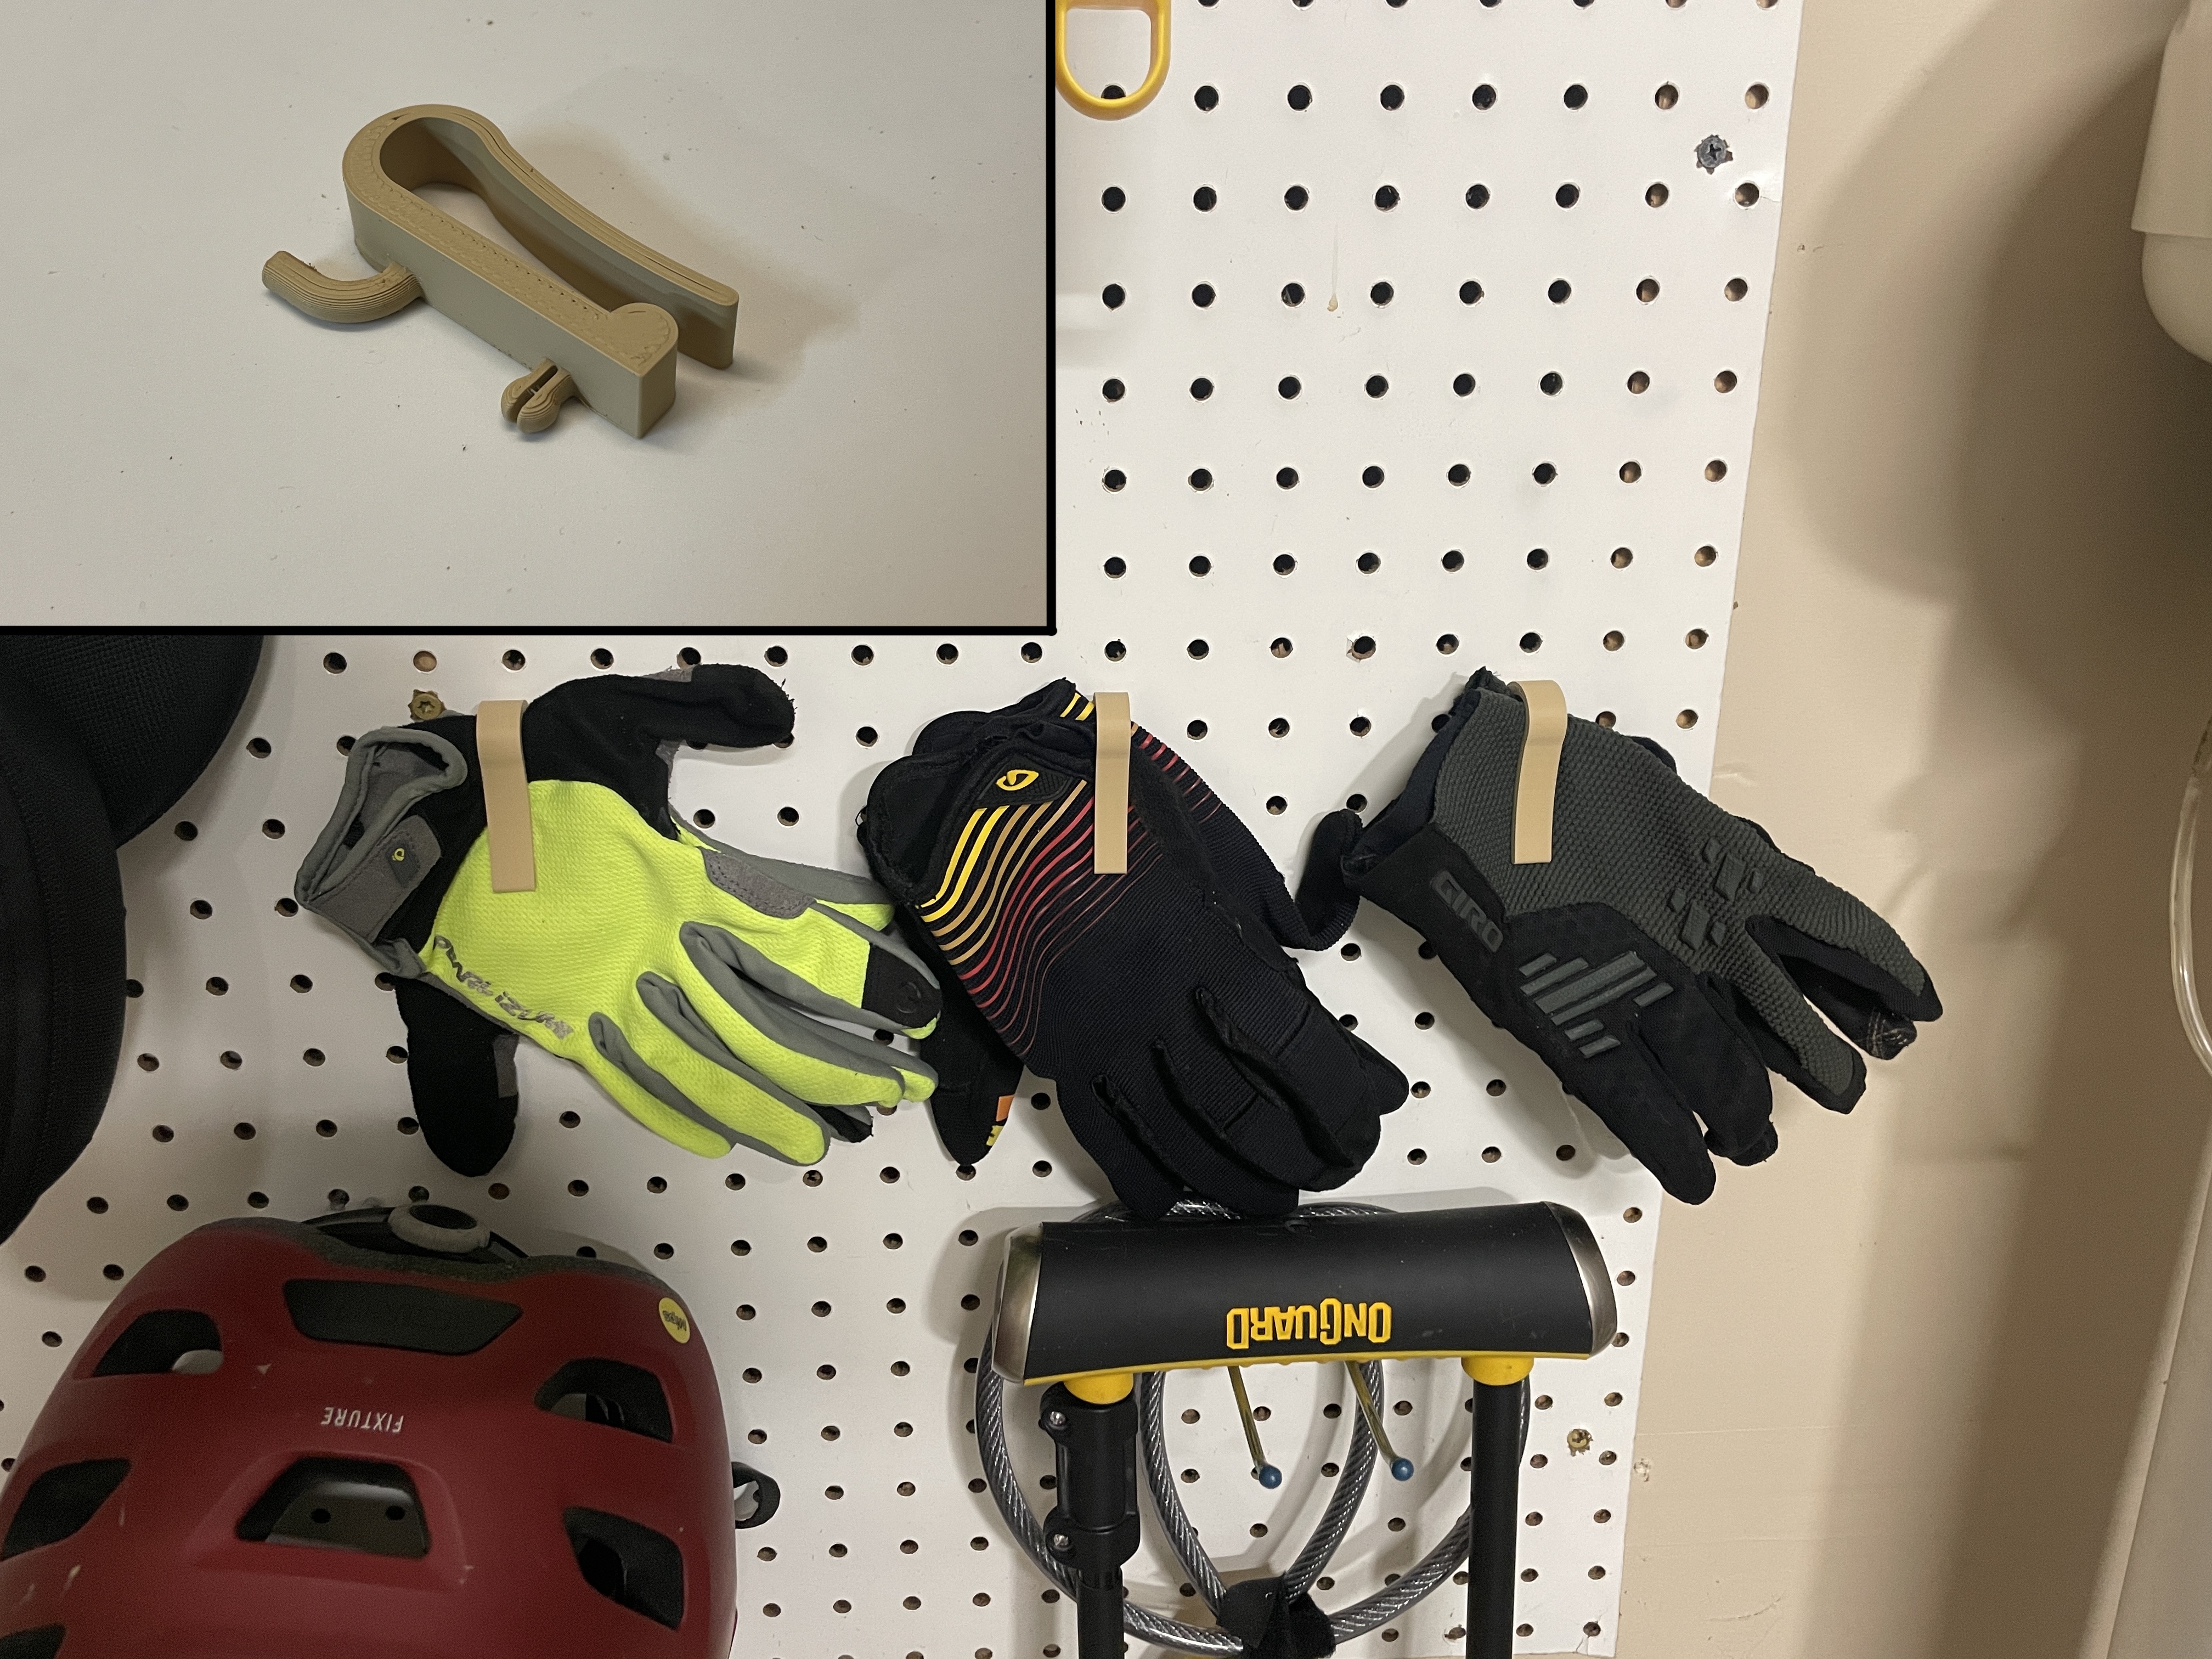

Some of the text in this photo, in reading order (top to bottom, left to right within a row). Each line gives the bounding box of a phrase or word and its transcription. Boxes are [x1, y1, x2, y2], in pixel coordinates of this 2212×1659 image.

[1430, 871, 1504, 952] GIRO
[1226, 1297, 1392, 1350] ONGUARD
[320, 1407, 404, 1433] FIXTURE
